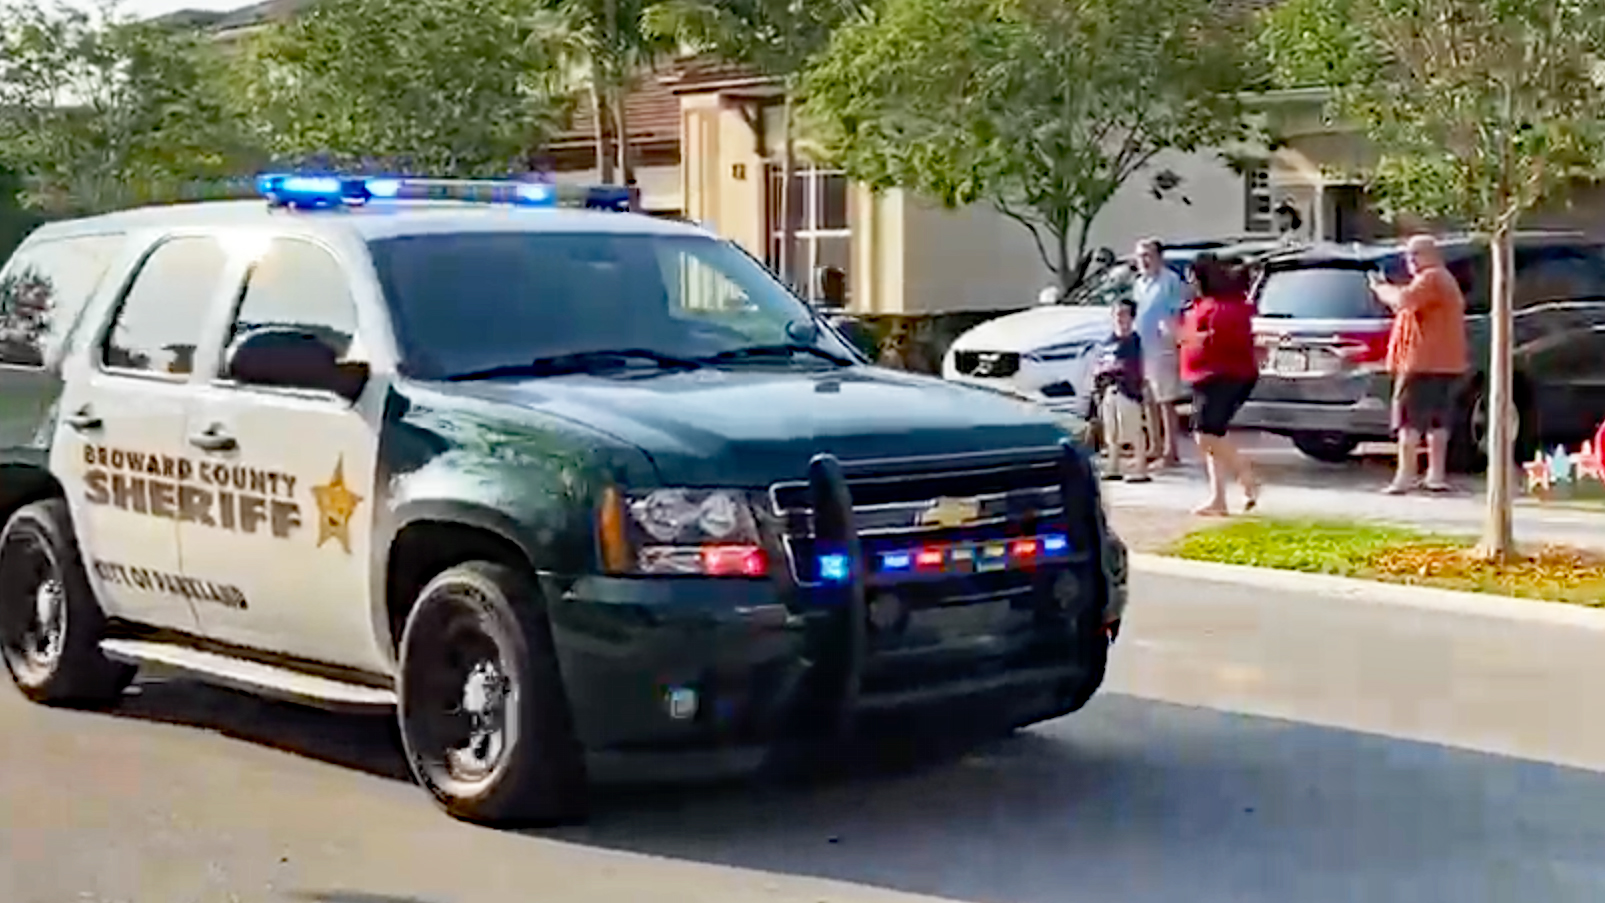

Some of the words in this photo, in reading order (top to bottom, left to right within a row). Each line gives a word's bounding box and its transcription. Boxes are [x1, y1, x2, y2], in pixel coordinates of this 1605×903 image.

[84, 444, 192, 480] BROWARD
[199, 461, 296, 498] COUNTY
[83, 469, 302, 539] SHERIFF
